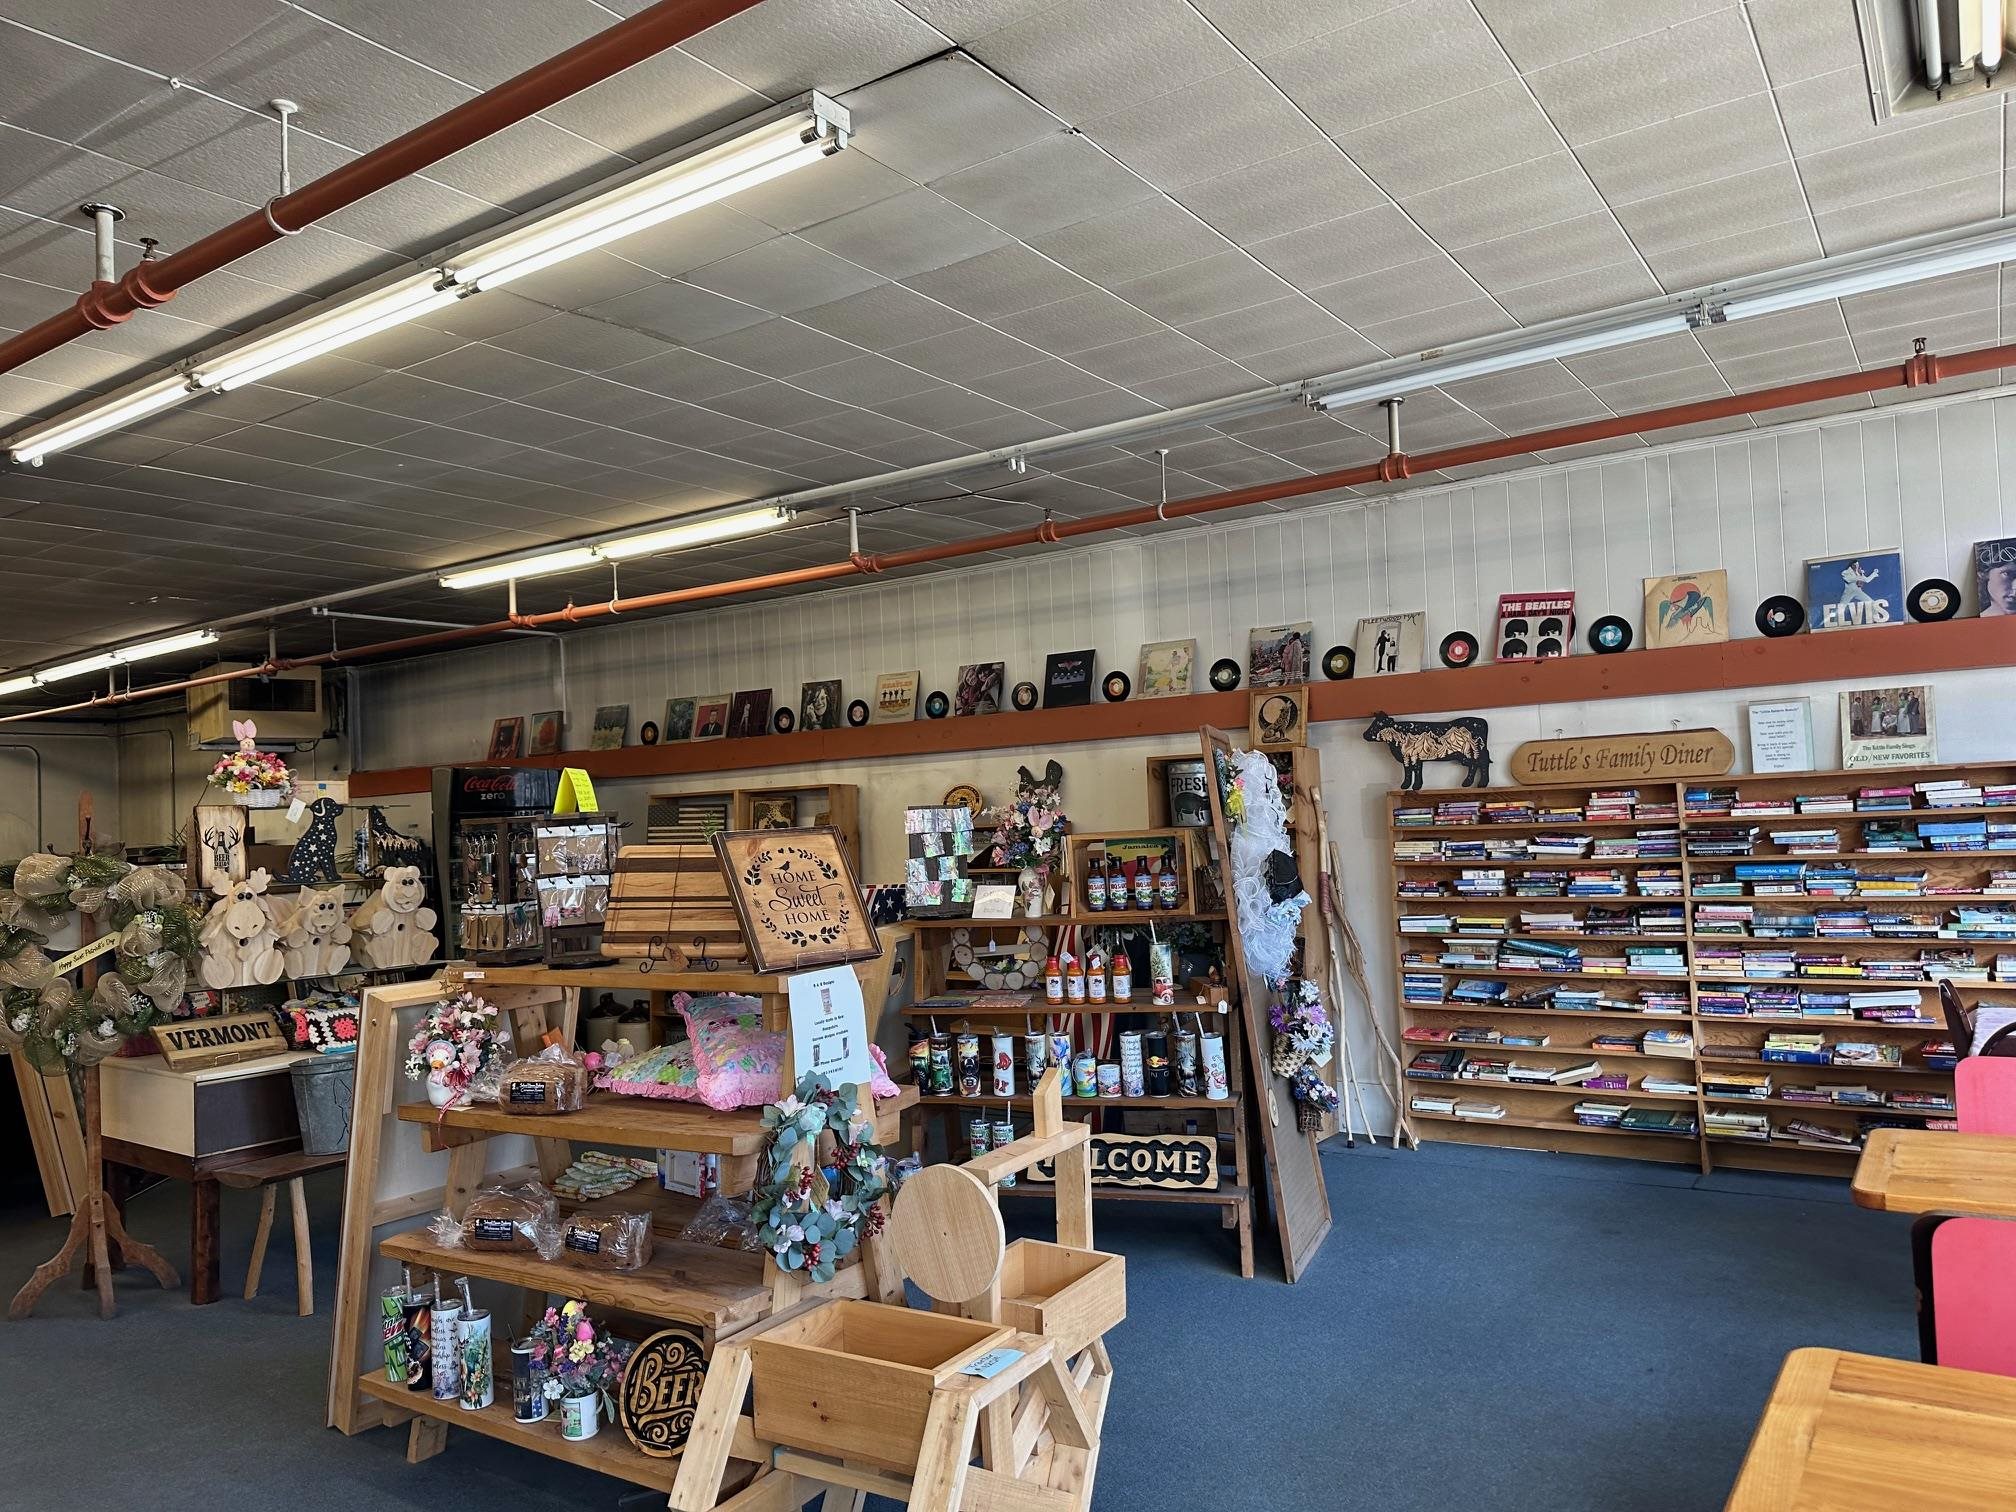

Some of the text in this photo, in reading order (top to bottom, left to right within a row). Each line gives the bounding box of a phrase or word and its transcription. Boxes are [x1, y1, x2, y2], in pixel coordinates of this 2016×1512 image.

[1501, 602, 1522, 612] THE
[1525, 600, 1571, 611] BEATLES
[1823, 599, 1889, 627] ELVIS
[1362, 614, 1402, 632] FLEETWOOD
[1527, 742, 1714, 774] Tuttle's Family Diner
[1891, 751, 1930, 760] FAVORITES
[480, 792, 506, 801] zero
[770, 869, 818, 885] HOME
[769, 883, 843, 912] Sweet
[784, 909, 831, 925] HOME
[166, 1020, 272, 1050] VERMONT
[1043, 1147, 1201, 1174] LCOME
[630, 1352, 705, 1414] BEER
